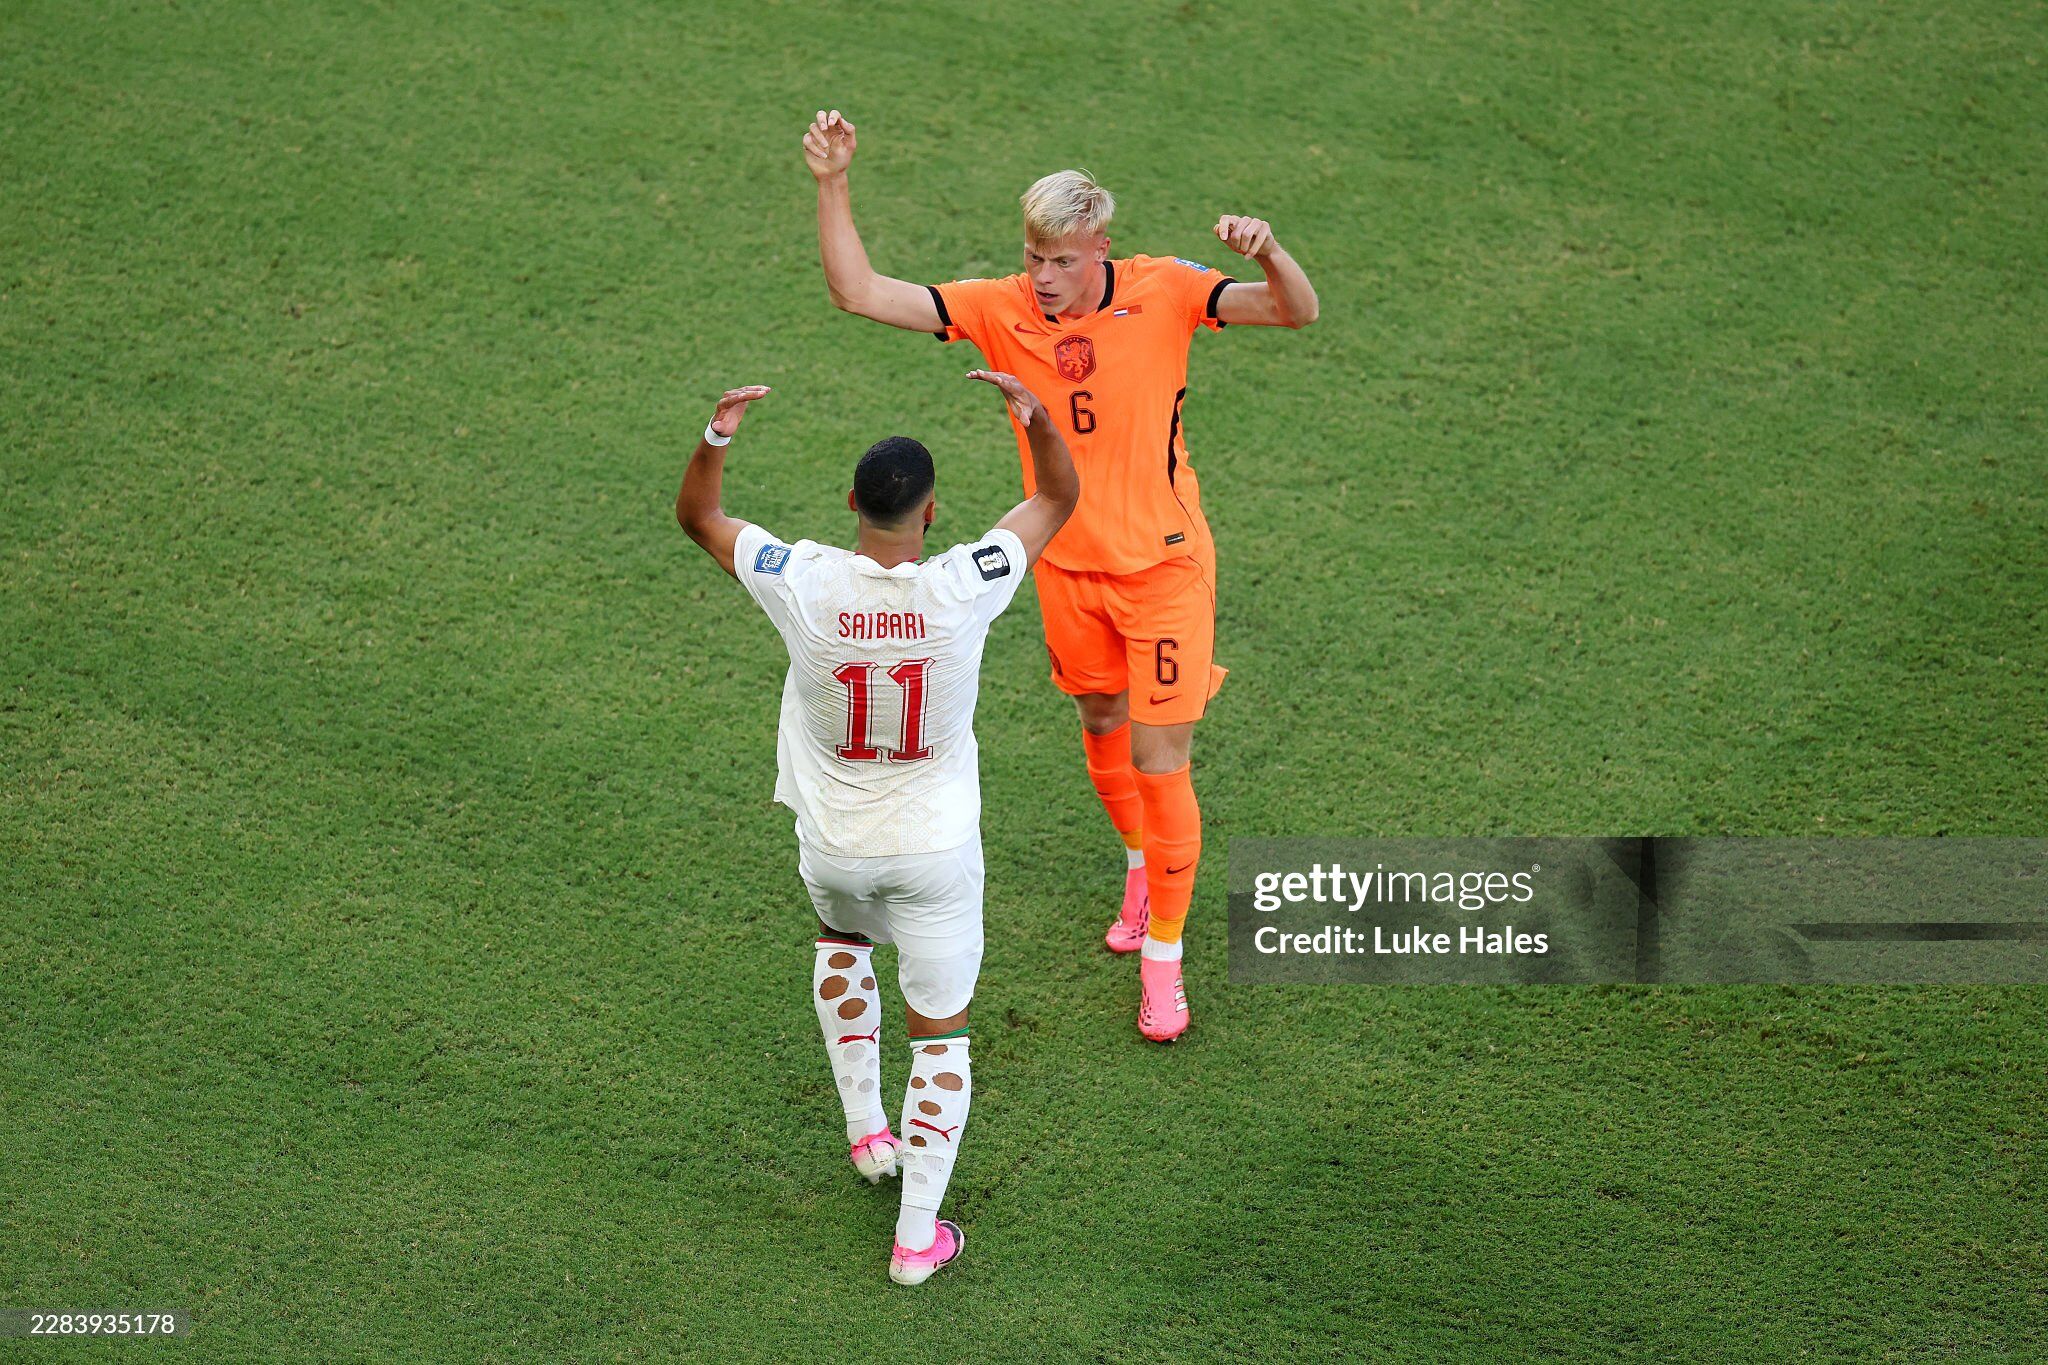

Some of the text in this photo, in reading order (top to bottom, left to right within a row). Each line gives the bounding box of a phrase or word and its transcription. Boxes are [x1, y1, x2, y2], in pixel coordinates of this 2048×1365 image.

[1069, 389, 1097, 435] 6
[838, 611, 926, 640] SAIBARI
[1154, 637, 1179, 687] 6
[831, 657, 936, 764] 11
